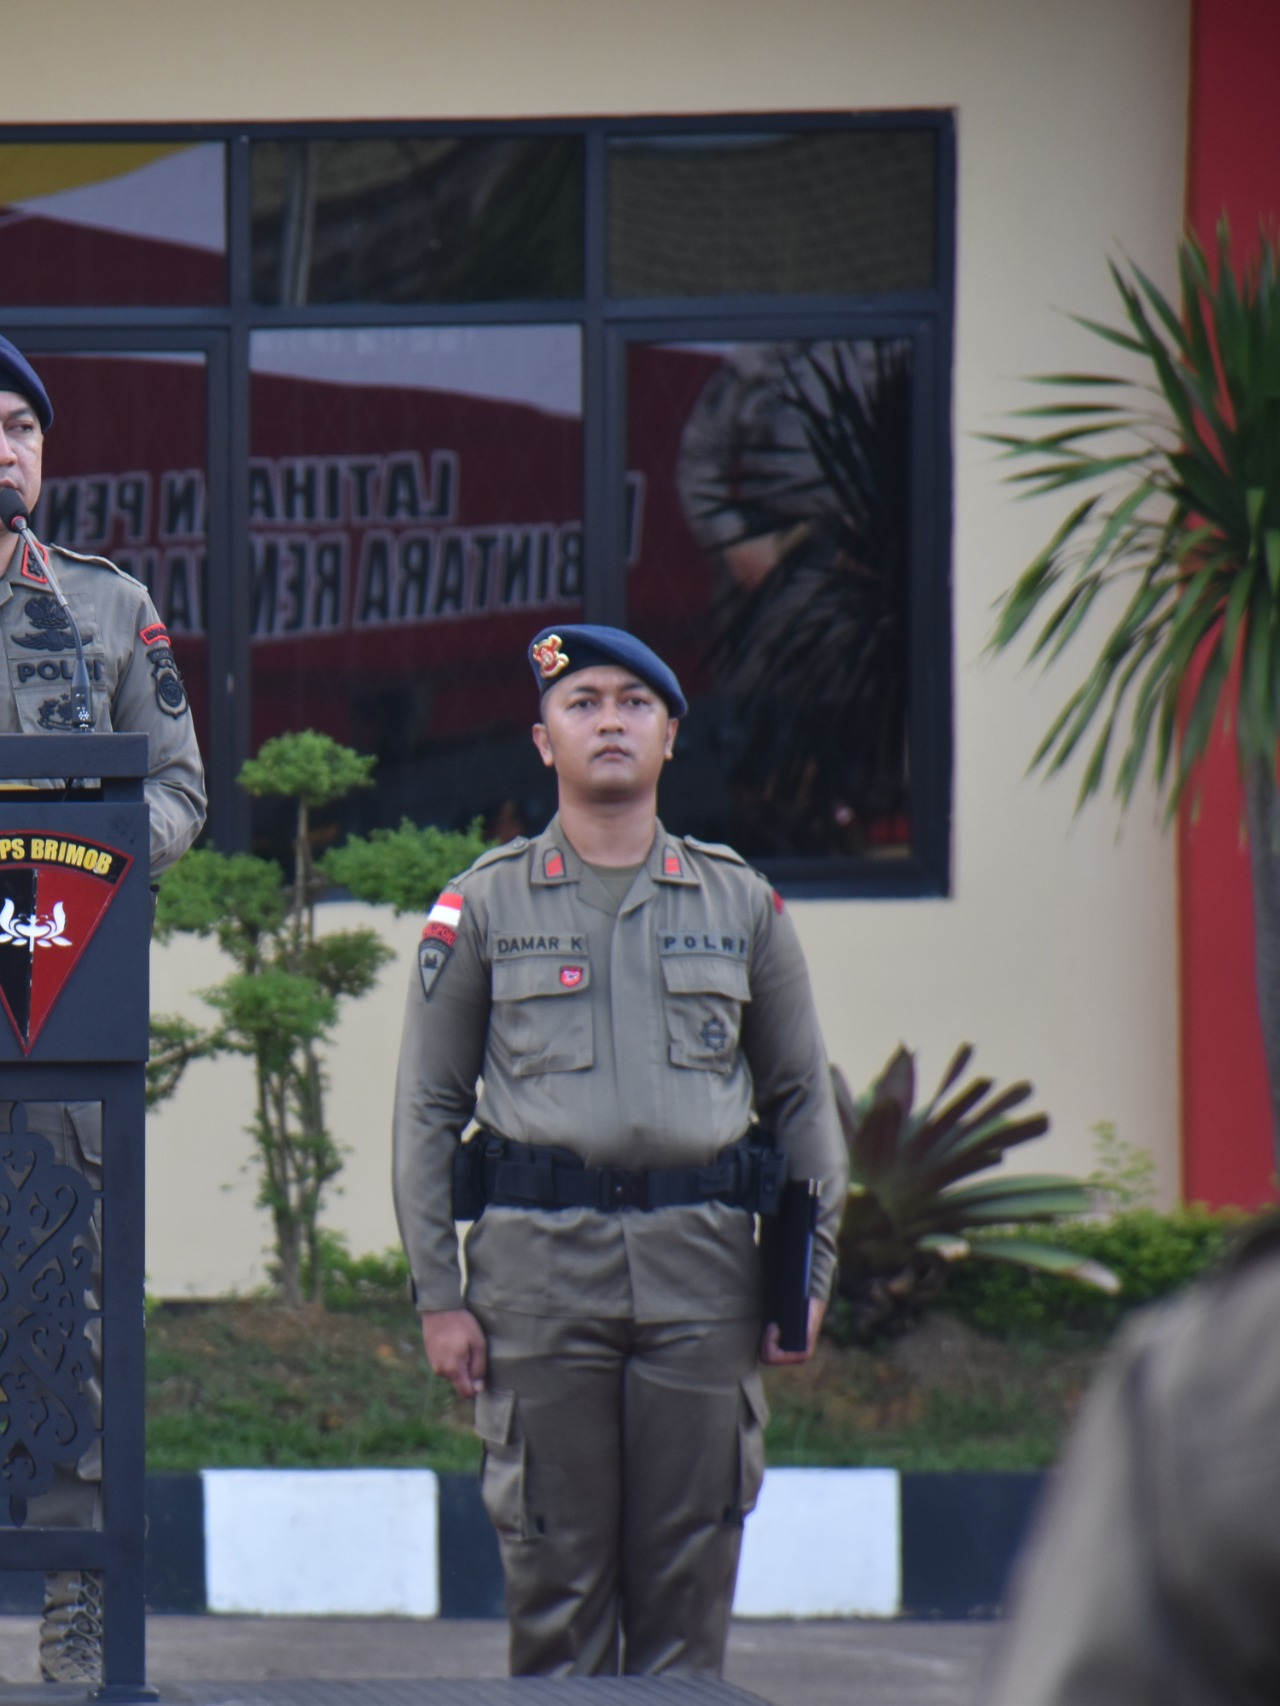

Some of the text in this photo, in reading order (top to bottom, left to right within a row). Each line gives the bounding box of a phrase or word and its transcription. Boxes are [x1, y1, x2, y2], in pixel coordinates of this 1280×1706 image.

[31, 838, 113, 875] BRIMOB
[498, 936, 582, 954] DAMAR K
[664, 935, 745, 953] POLRI
